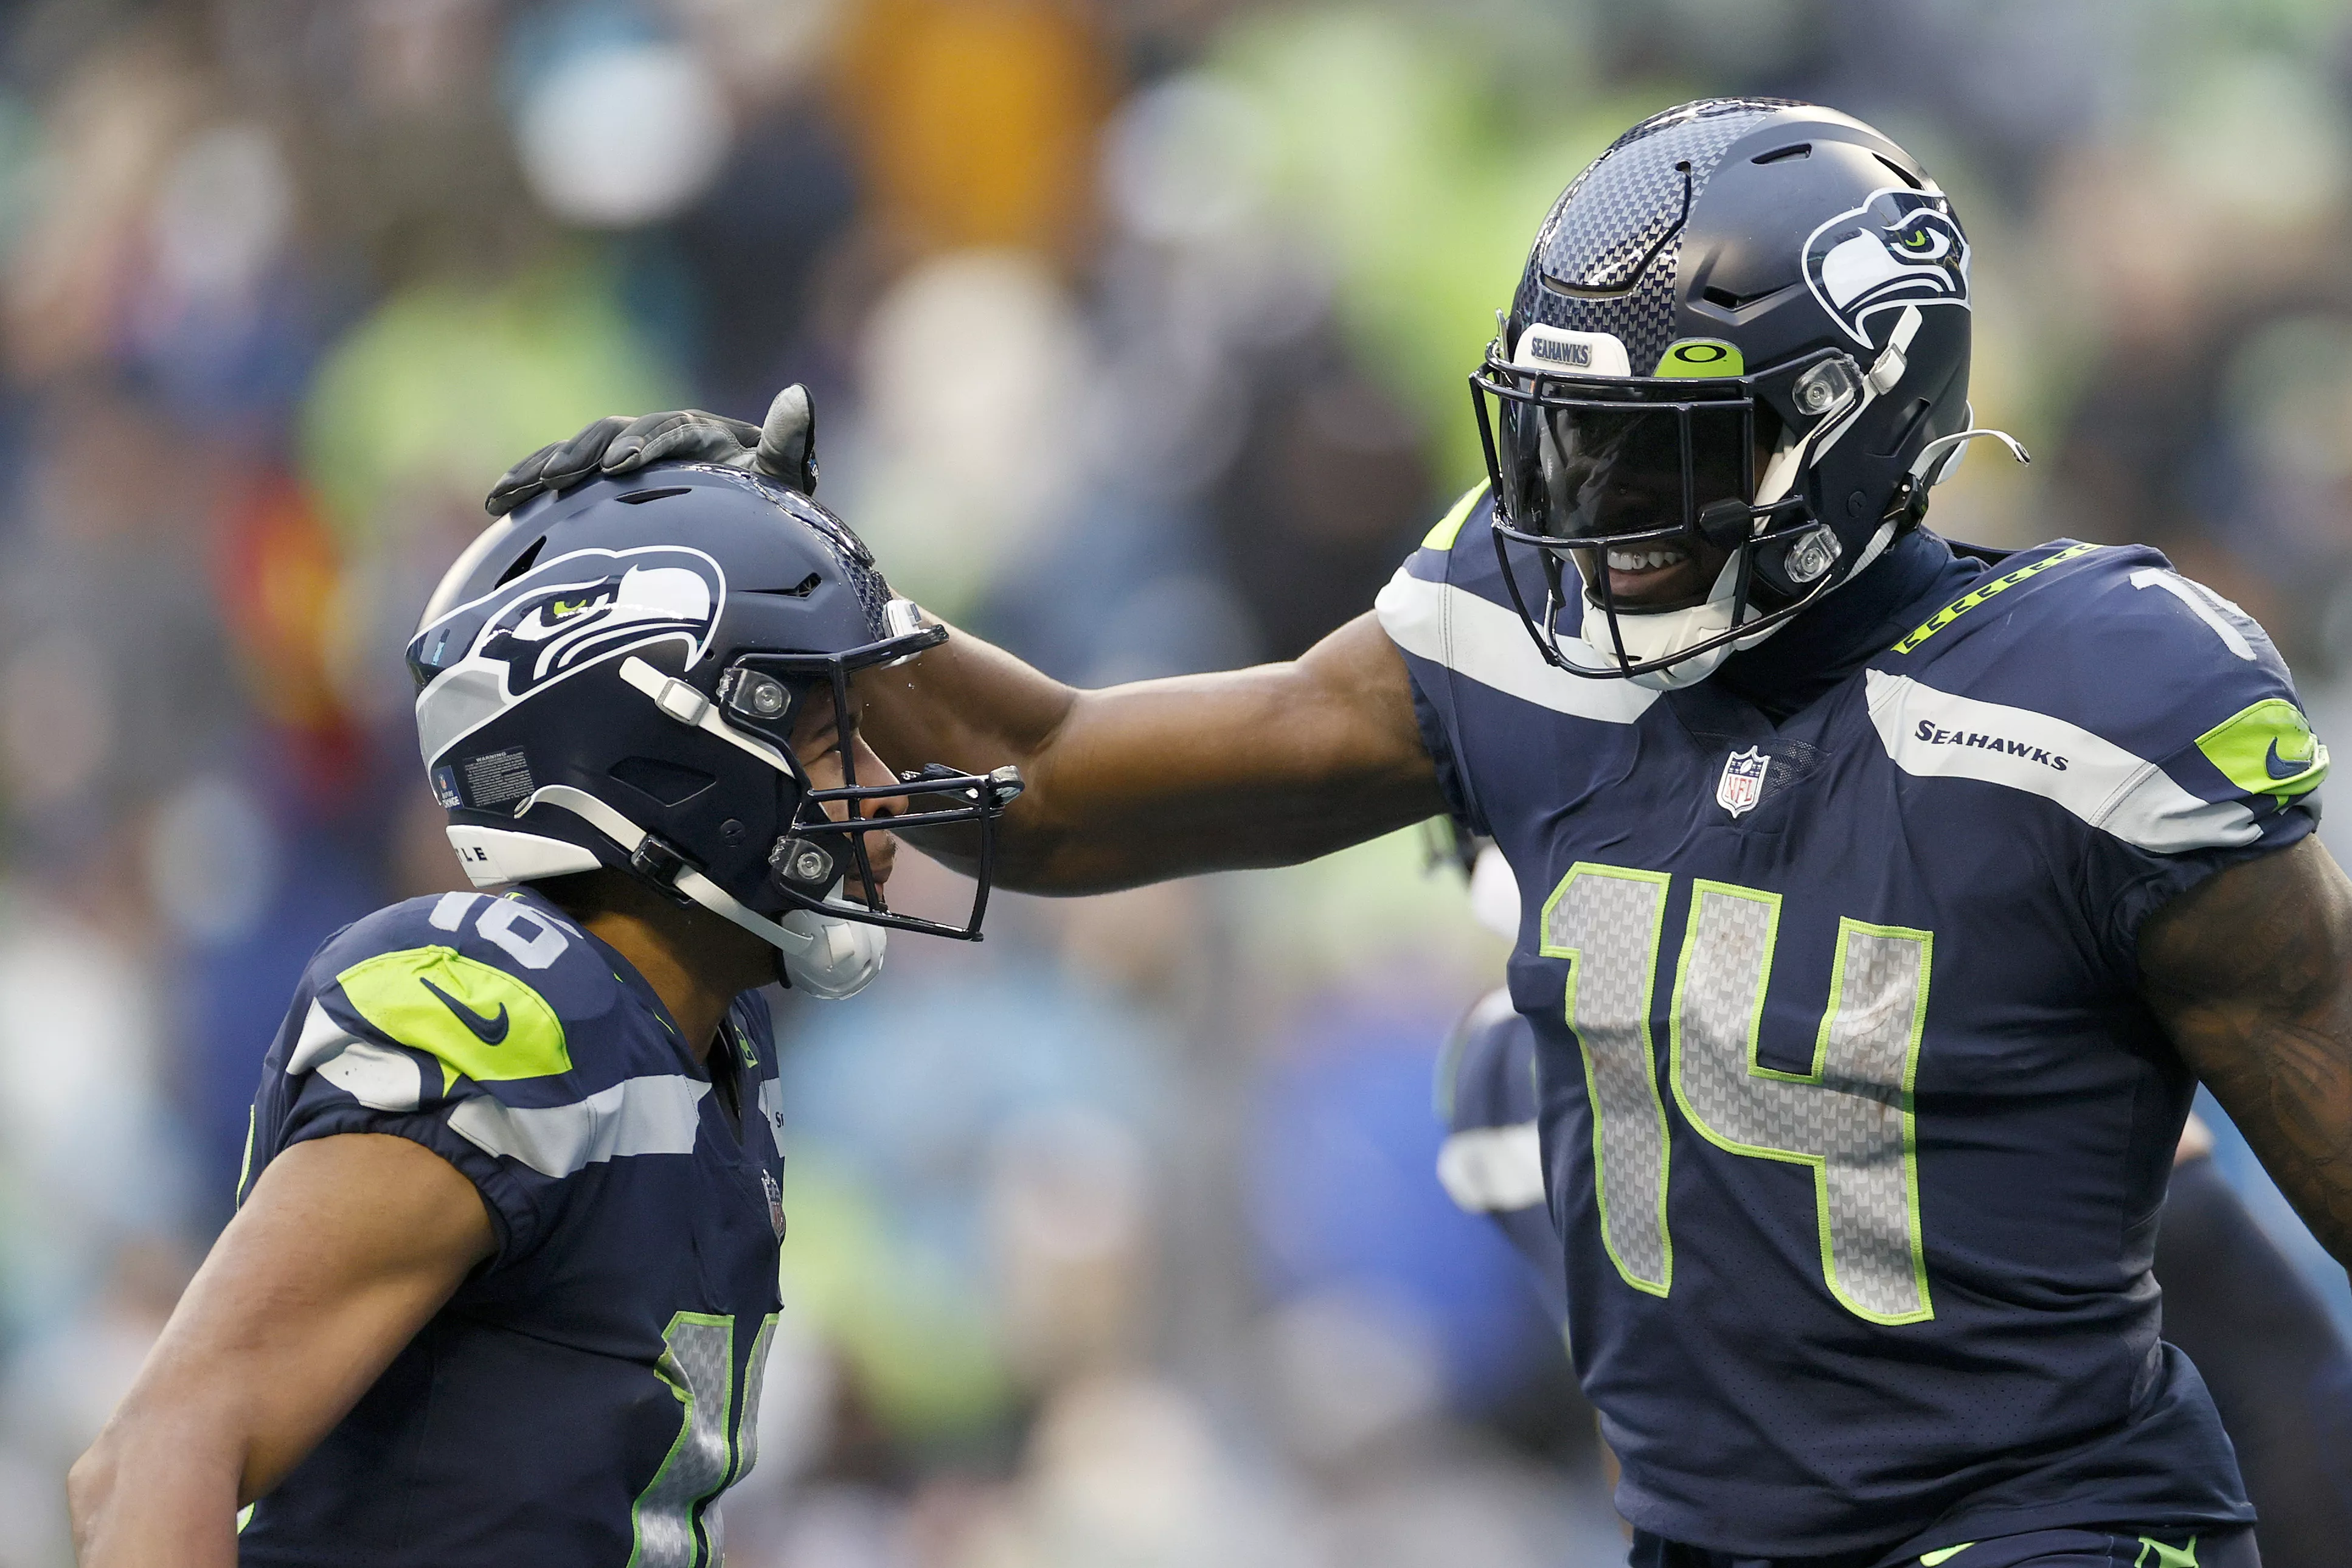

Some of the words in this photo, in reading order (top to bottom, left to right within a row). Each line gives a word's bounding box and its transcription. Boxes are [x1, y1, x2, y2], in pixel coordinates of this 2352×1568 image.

[1531, 335, 1589, 365] SEAHAWKS
[2129, 567, 2257, 661] 1
[476, 751, 507, 763] WARNING
[1915, 720, 2069, 771] SEAHAWKS
[1725, 775, 1753, 804] NFL
[1539, 861, 1935, 1326] 14
